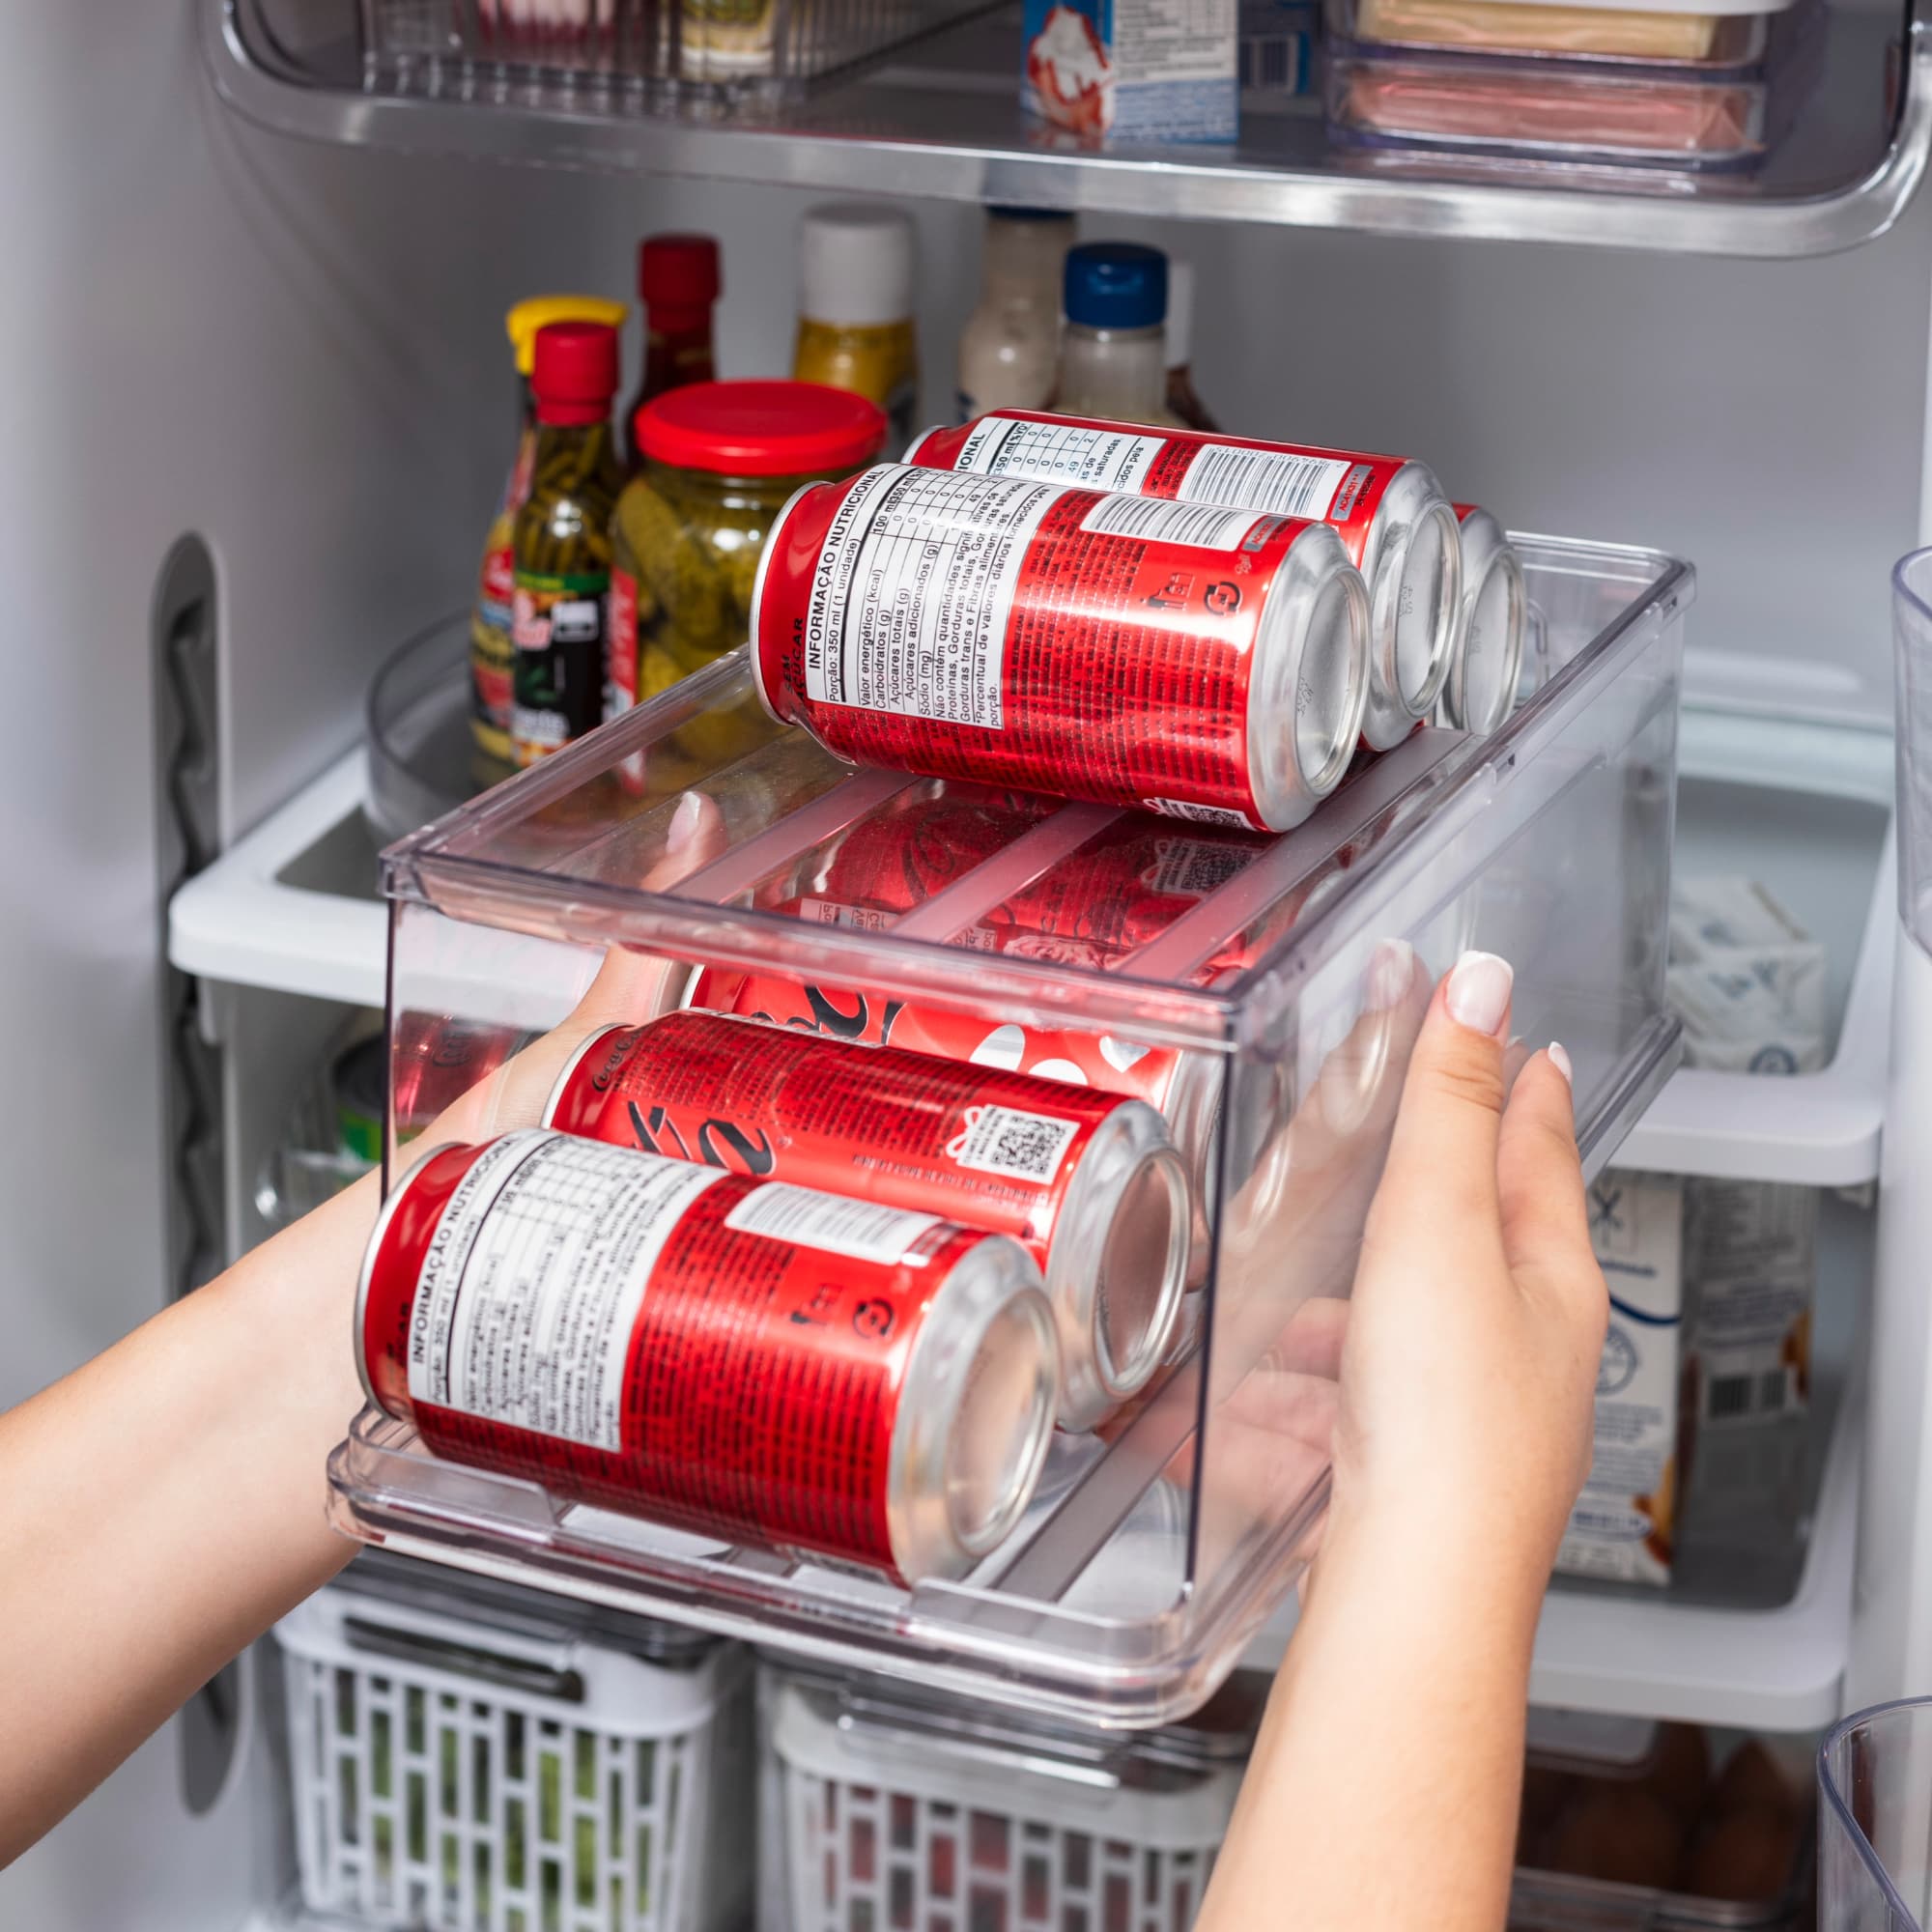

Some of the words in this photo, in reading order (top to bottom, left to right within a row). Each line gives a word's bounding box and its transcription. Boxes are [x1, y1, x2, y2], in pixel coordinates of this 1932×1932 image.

[1132, 446, 1145, 463] pela
[873, 516, 888, 535] 100
[892, 488, 903, 502] 350
[969, 494, 981, 502] 49
[956, 500, 991, 561] signifativas
[971, 508, 1000, 552] Goruras
[979, 512, 1011, 572] alimentres.
[809, 552, 836, 669] INFORMAÇÃO
[828, 470, 885, 547] NUTRICIONAL
[837, 538, 862, 590] unidade)
[923, 544, 939, 560] (g)
[959, 555, 979, 590] totais,
[992, 543, 1012, 580] diários
[867, 569, 883, 603] (kcal)
[897, 587, 909, 605] (g)
[909, 563, 930, 639] adicionados
[939, 564, 962, 641] quantidades
[966, 574, 984, 614] Fibras
[981, 583, 998, 630] valores
[832, 610, 841, 626] ml
[878, 610, 891, 628] (g)
[893, 609, 904, 643] totais
[948, 593, 965, 654] Gorduras
[792, 618, 806, 700] AÇÚCAR
[828, 630, 838, 654] 350
[861, 608, 874, 674] energético
[961, 630, 973, 662] trans
[979, 635, 988, 650] de
[781, 655, 793, 693] SEM
[828, 656, 841, 702] Porção:
[873, 631, 886, 709] Carboidratos
[889, 648, 901, 705] Açúcares
[904, 642, 917, 700] Açúcares
[919, 650, 933, 679] (mg)
[935, 645, 946, 692] contém
[860, 678, 871, 706] Valor
[920, 683, 931, 716] Sódio
[936, 696, 946, 718] Não
[948, 660, 959, 721] Proteínas,
[959, 664, 971, 723] Gorduras
[988, 684, 1000, 726] porção.
[412, 1226, 452, 1363] INFORMAÇÃO
